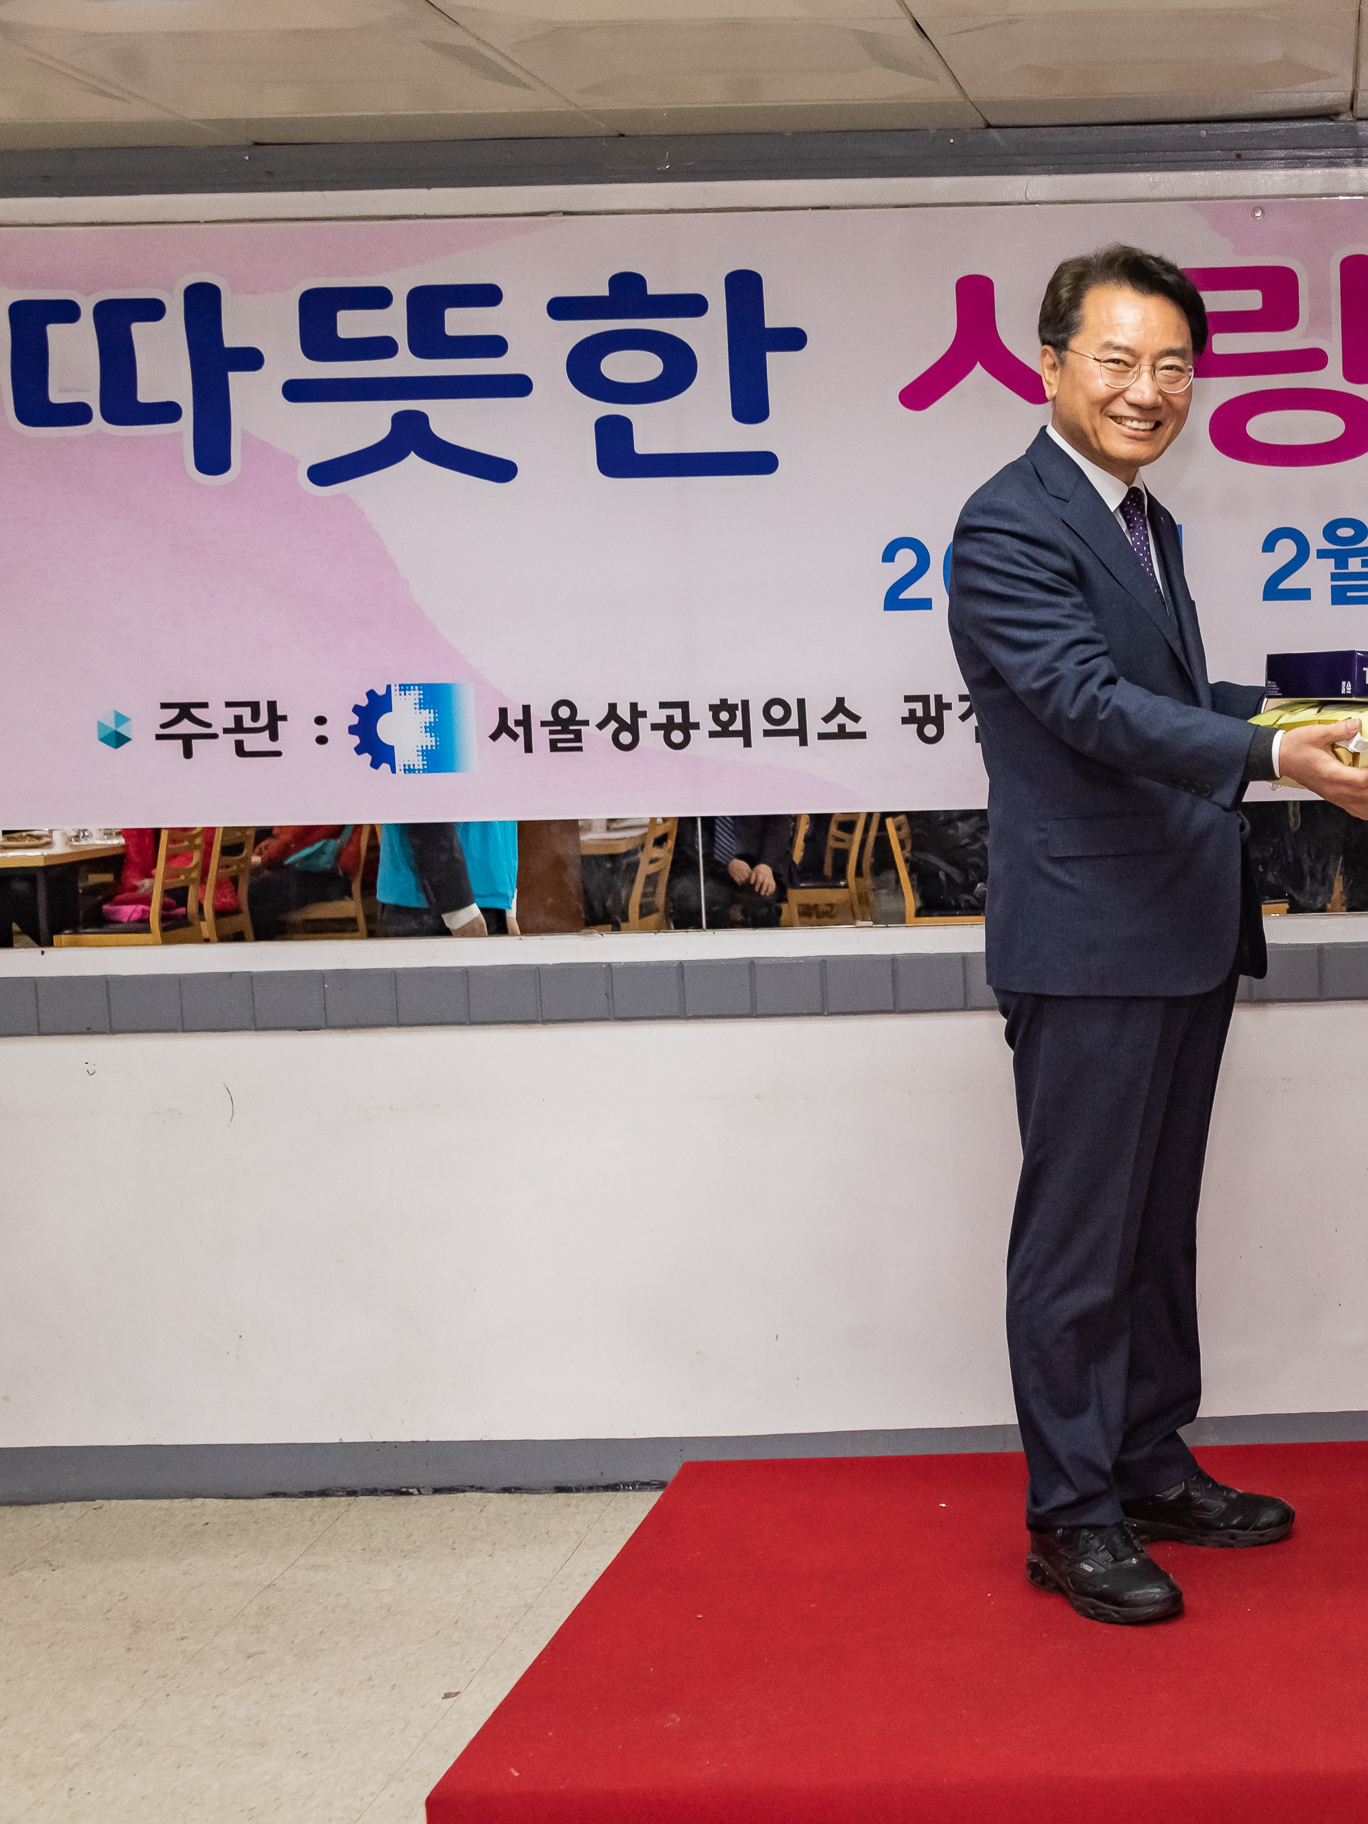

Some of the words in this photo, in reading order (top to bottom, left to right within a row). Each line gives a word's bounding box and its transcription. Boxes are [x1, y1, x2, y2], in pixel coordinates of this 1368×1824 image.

[8, 269, 808, 487] 따뜻한
[155, 700, 288, 760] 주관
[488, 696, 867, 754] 서울상공회의소
